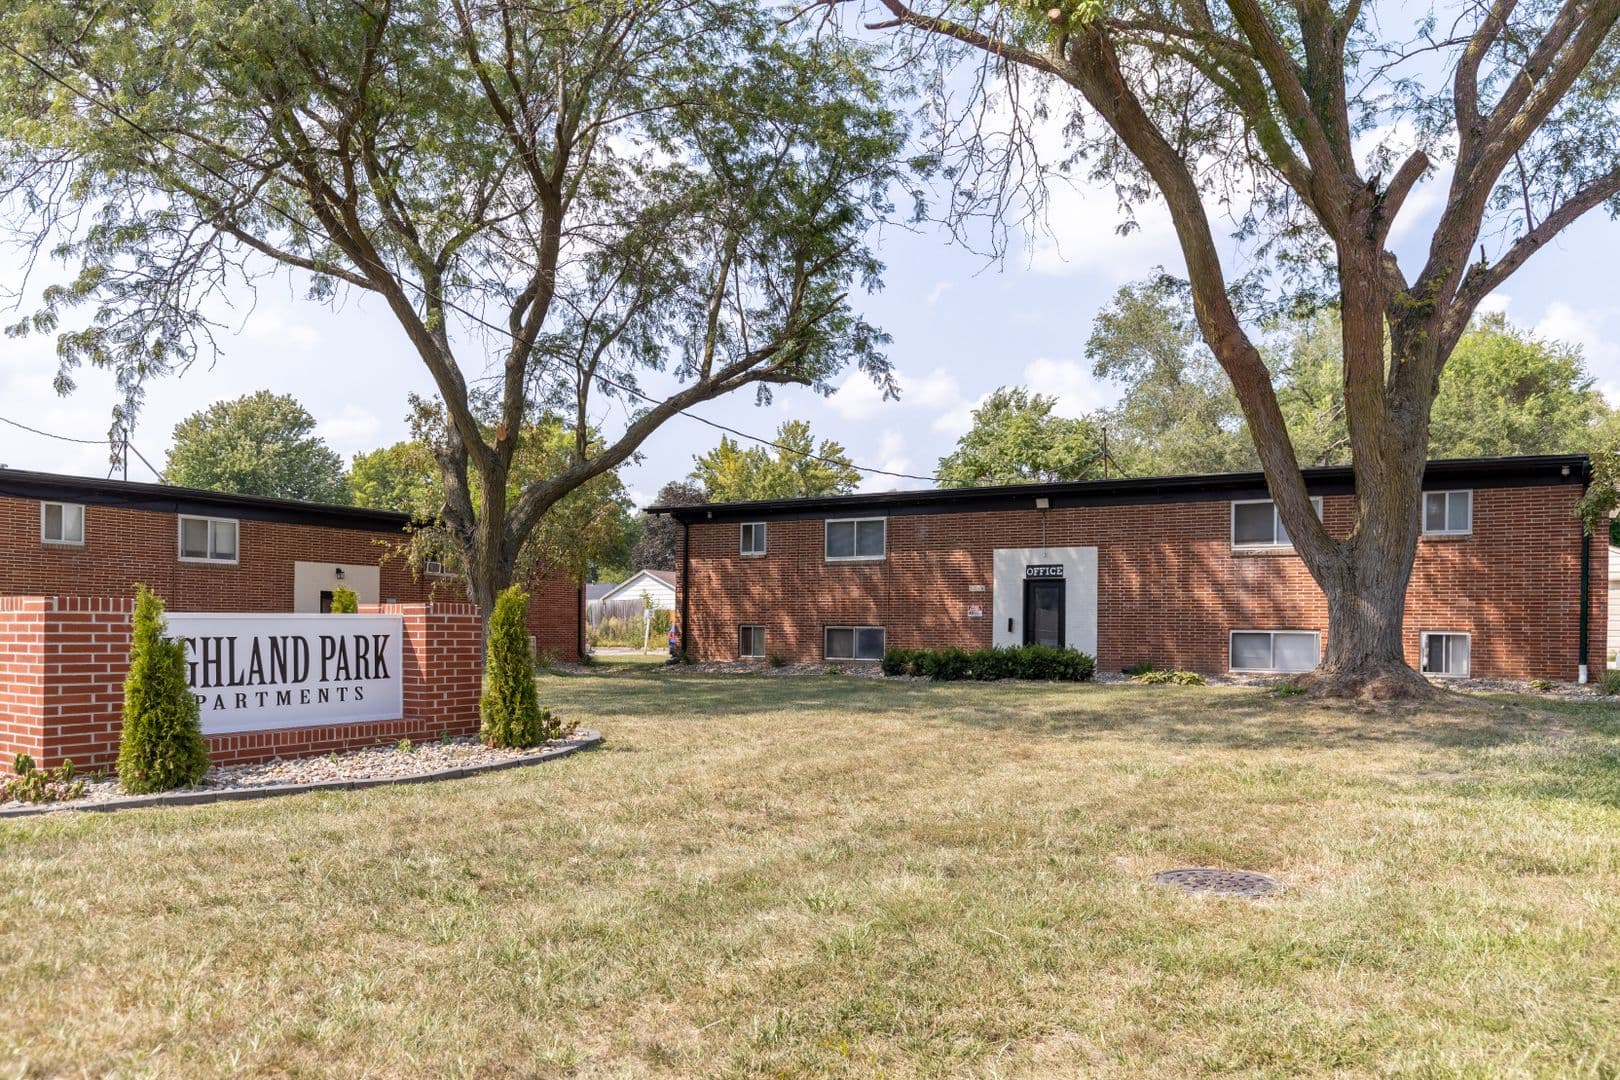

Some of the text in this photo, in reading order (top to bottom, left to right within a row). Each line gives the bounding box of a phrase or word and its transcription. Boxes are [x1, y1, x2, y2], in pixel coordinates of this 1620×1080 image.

[1026, 566, 1063, 576] OFFICE
[162, 634, 391, 689] GHLAND PARK
[195, 686, 364, 711] PARTMENTS
